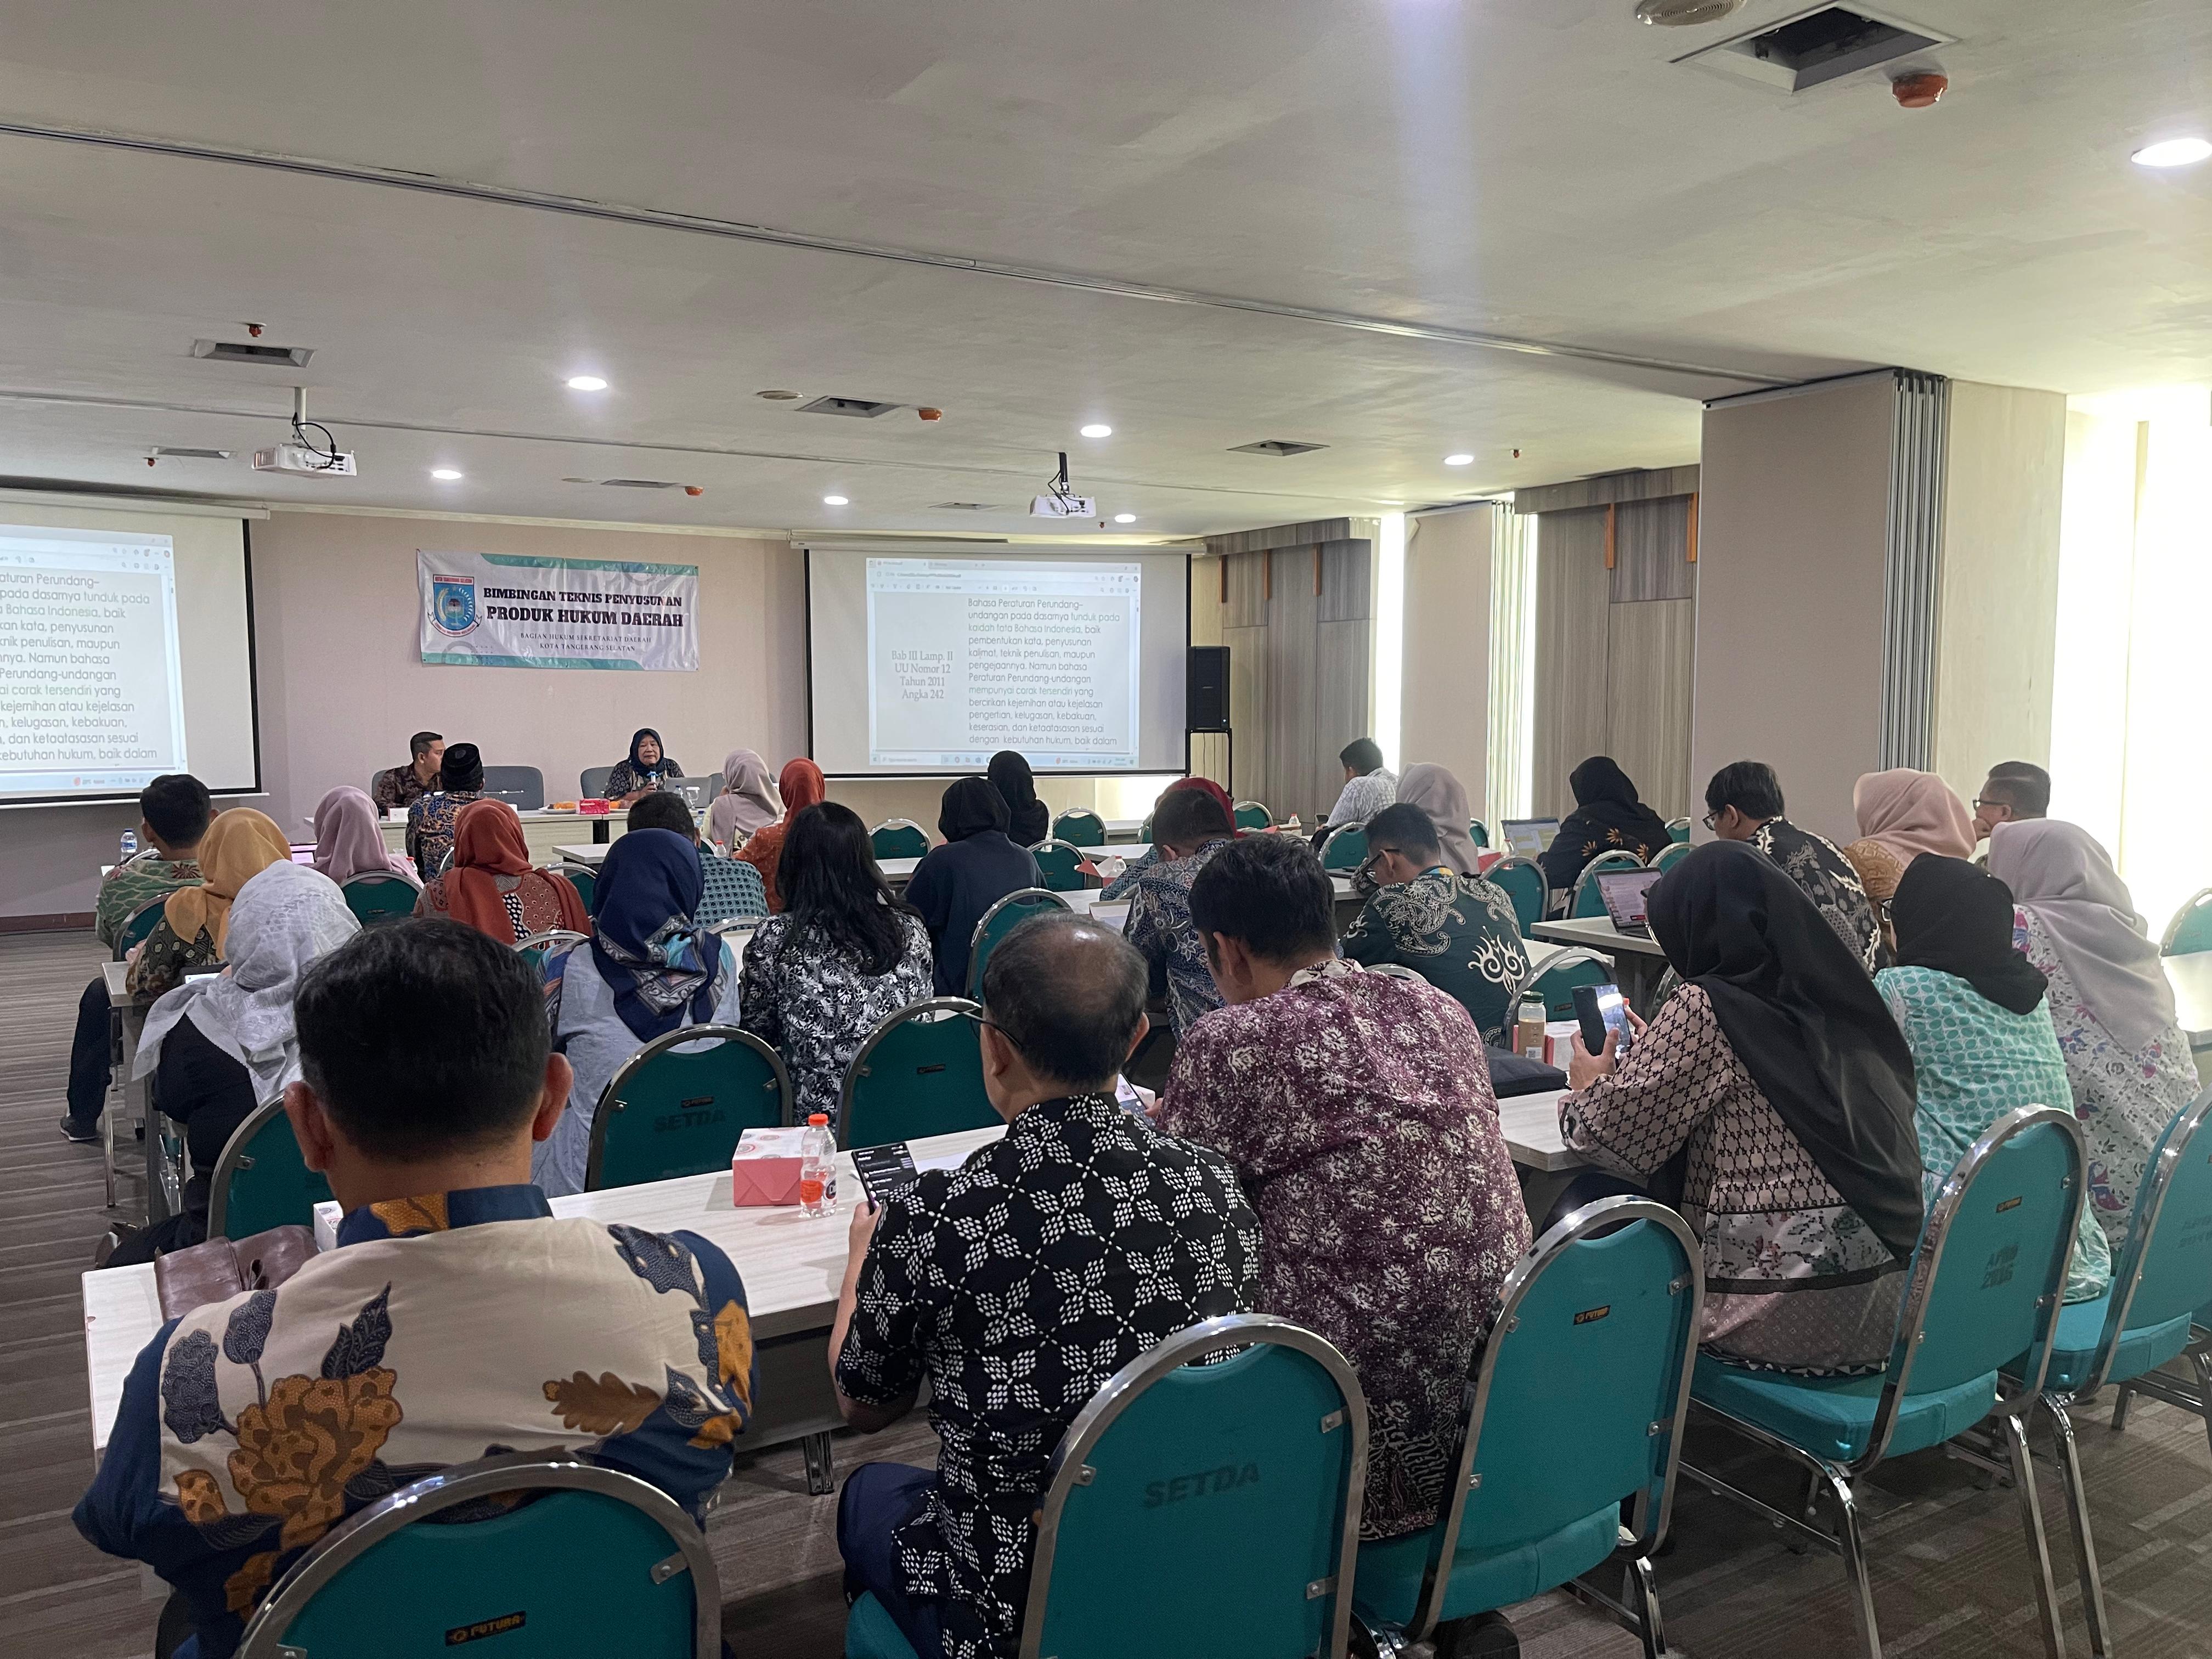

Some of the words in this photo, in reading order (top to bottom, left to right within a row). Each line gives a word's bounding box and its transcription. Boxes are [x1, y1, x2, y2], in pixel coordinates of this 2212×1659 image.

[1, 589, 29, 600] pada
[84, 592, 119, 602] tunduk
[122, 594, 149, 604] pada
[484, 588, 555, 601] BIMBINGAN
[559, 591, 602, 602] TEKNIS
[605, 594, 681, 606] PENYUSUNAN
[968, 599, 996, 607] Bahasa
[998, 599, 1035, 607] Peraturan
[7, 605, 44, 615] Bahasa
[104, 608, 126, 618] baik
[487, 606, 554, 622] PRODUK
[558, 610, 617, 624] HUKUM
[622, 612, 683, 627] DAERAH
[969, 612, 1008, 620] undangan
[1099, 614, 1120, 623] pada
[21, 620, 47, 632] kata,
[51, 623, 114, 634] penyusunan
[969, 624, 994, 632] kaidah
[1015, 624, 1042, 633] Bahasa
[77, 640, 120, 651] maupun
[969, 637, 1022, 646] pembentukan
[1025, 637, 1043, 646] kata,
[1046, 639, 1091, 647] penyusunan
[29, 653, 67, 663] Namun
[71, 653, 109, 664] bahasa
[892, 650, 906, 659] Bab
[909, 651, 917, 660] III
[920, 651, 945, 663] Lamp.
[947, 651, 952, 661] II
[1001, 649, 1022, 657] teknik
[1024, 650, 1062, 659] penulisan,
[1064, 651, 1095, 660] maupun
[895, 663, 909, 673] UU
[911, 663, 939, 673] Nomor
[941, 664, 950, 673] 12
[969, 663, 1026, 672] pengejaannya.
[1029, 662, 1056, 670] Namun
[900, 676, 926, 686] Tahun
[928, 676, 944, 686] 2011
[969, 673, 1005, 682] Peraturan
[1008, 674, 1091, 684] Perundang-undangan
[12, 685, 42, 695] corak
[46, 685, 91, 695] tersendiri
[94, 687, 121, 698] yang
[902, 689, 928, 701] Angka
[930, 690, 944, 698] 242
[969, 687, 1014, 696] mempunyai
[1075, 689, 1093, 697] yang
[59, 702, 82, 712] atau
[86, 701, 134, 714] kejelasan
[969, 698, 1006, 707] bercirikan
[1068, 700, 1102, 709] kejelasan
[969, 711, 1012, 720] pengertian,
[1015, 712, 1054, 721] kelugasan,
[1057, 712, 1096, 721] kebakuan,
[72, 716, 127, 728] kebakuan,
[969, 723, 1010, 732] keserasian,
[1029, 724, 1080, 732] ketaatasasan
[1082, 724, 1104, 733] sesuai
[9, 733, 30, 744] dan
[33, 733, 104, 743] ketaatasasan
[108, 732, 138, 743] sesuai
[969, 736, 999, 745] dengan
[1003, 736, 1043, 744] kebutuhan
[1093, 737, 1117, 745] dalam
[58, 749, 95, 759] hukum,
[99, 749, 121, 759] baik
[124, 749, 157, 758] dalam
[1143, 1462, 1260, 1509] SETDA
